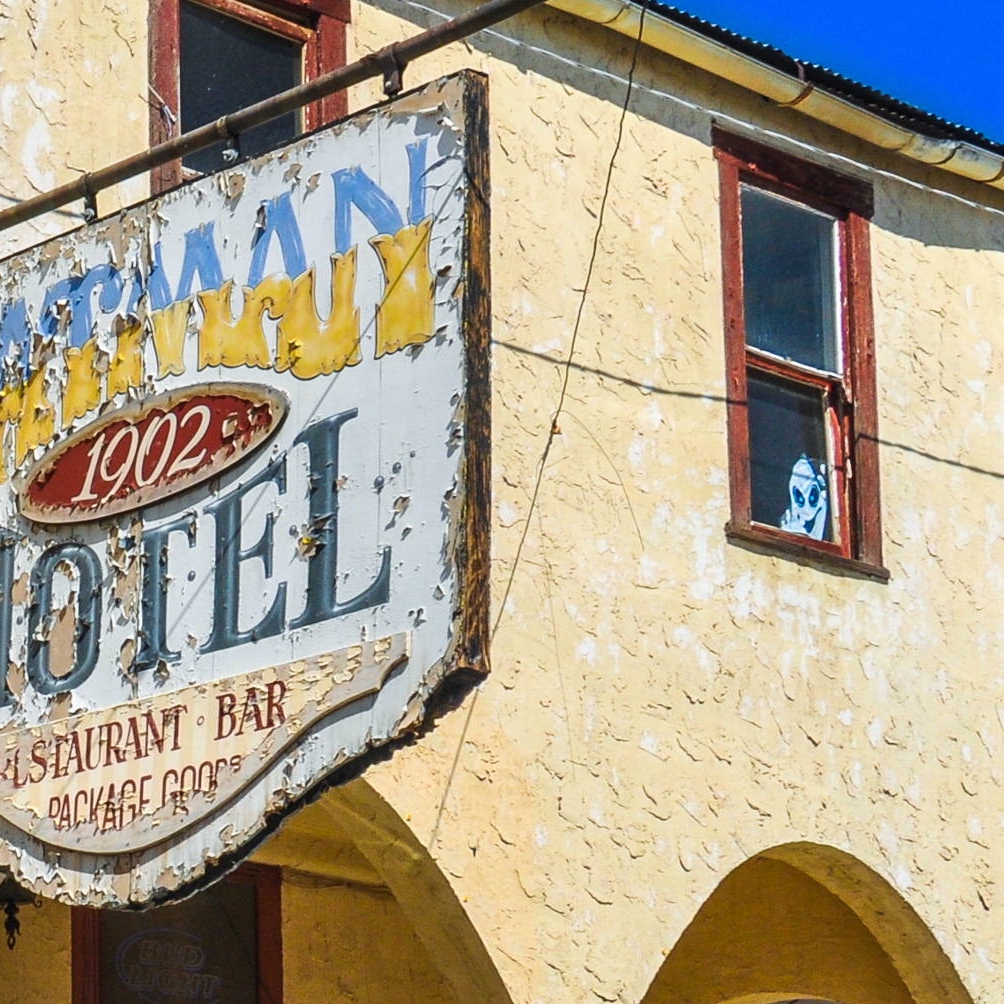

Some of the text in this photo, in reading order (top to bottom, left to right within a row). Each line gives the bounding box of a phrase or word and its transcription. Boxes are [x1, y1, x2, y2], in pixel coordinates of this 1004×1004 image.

[71, 404, 212, 504] 1902
[214, 680, 288, 741] BAR
[48, 774, 153, 833] PACKAGE
